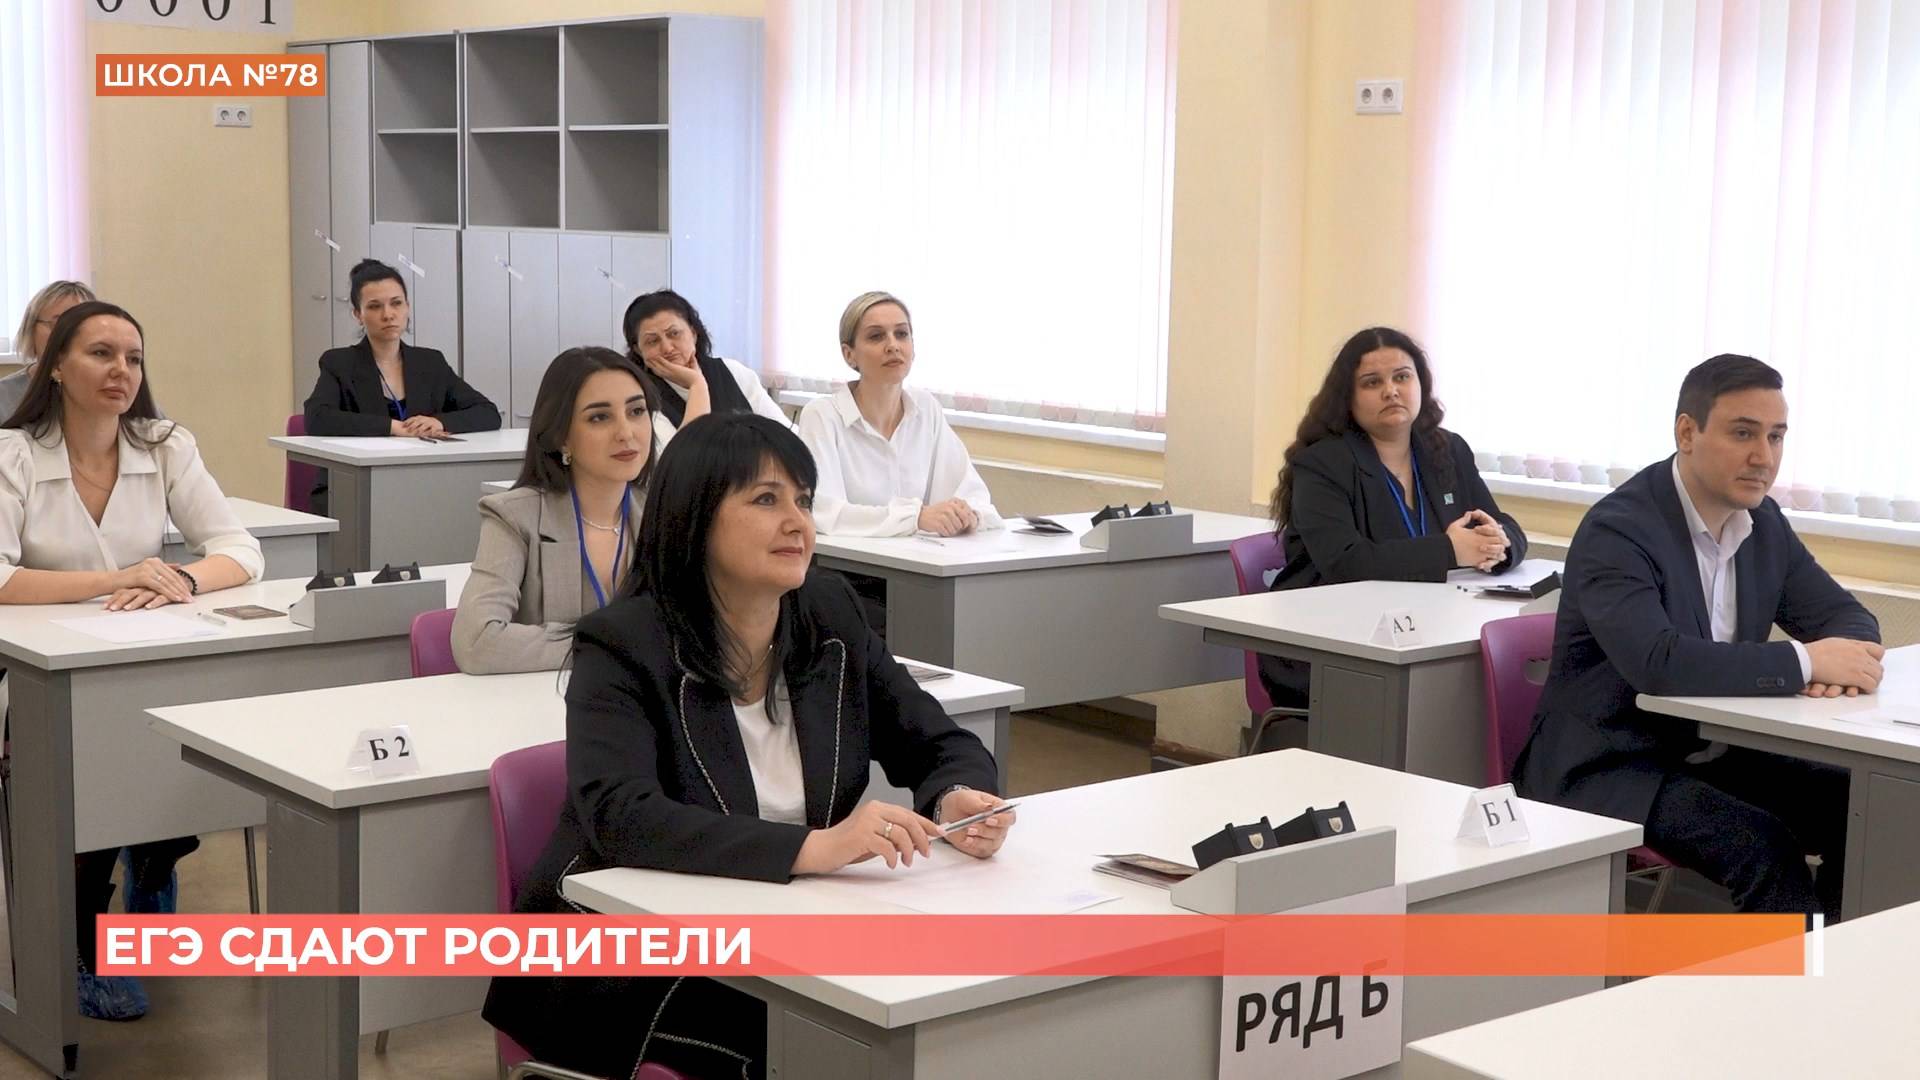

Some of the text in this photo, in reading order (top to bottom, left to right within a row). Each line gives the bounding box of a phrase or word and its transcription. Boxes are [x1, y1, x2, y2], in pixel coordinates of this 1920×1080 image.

[1393, 615, 1416, 633] А 2
[368, 735, 410, 761] Б 2
[1481, 798, 1517, 827] Б 1
[1235, 959, 1390, 1053] РЯД Б
